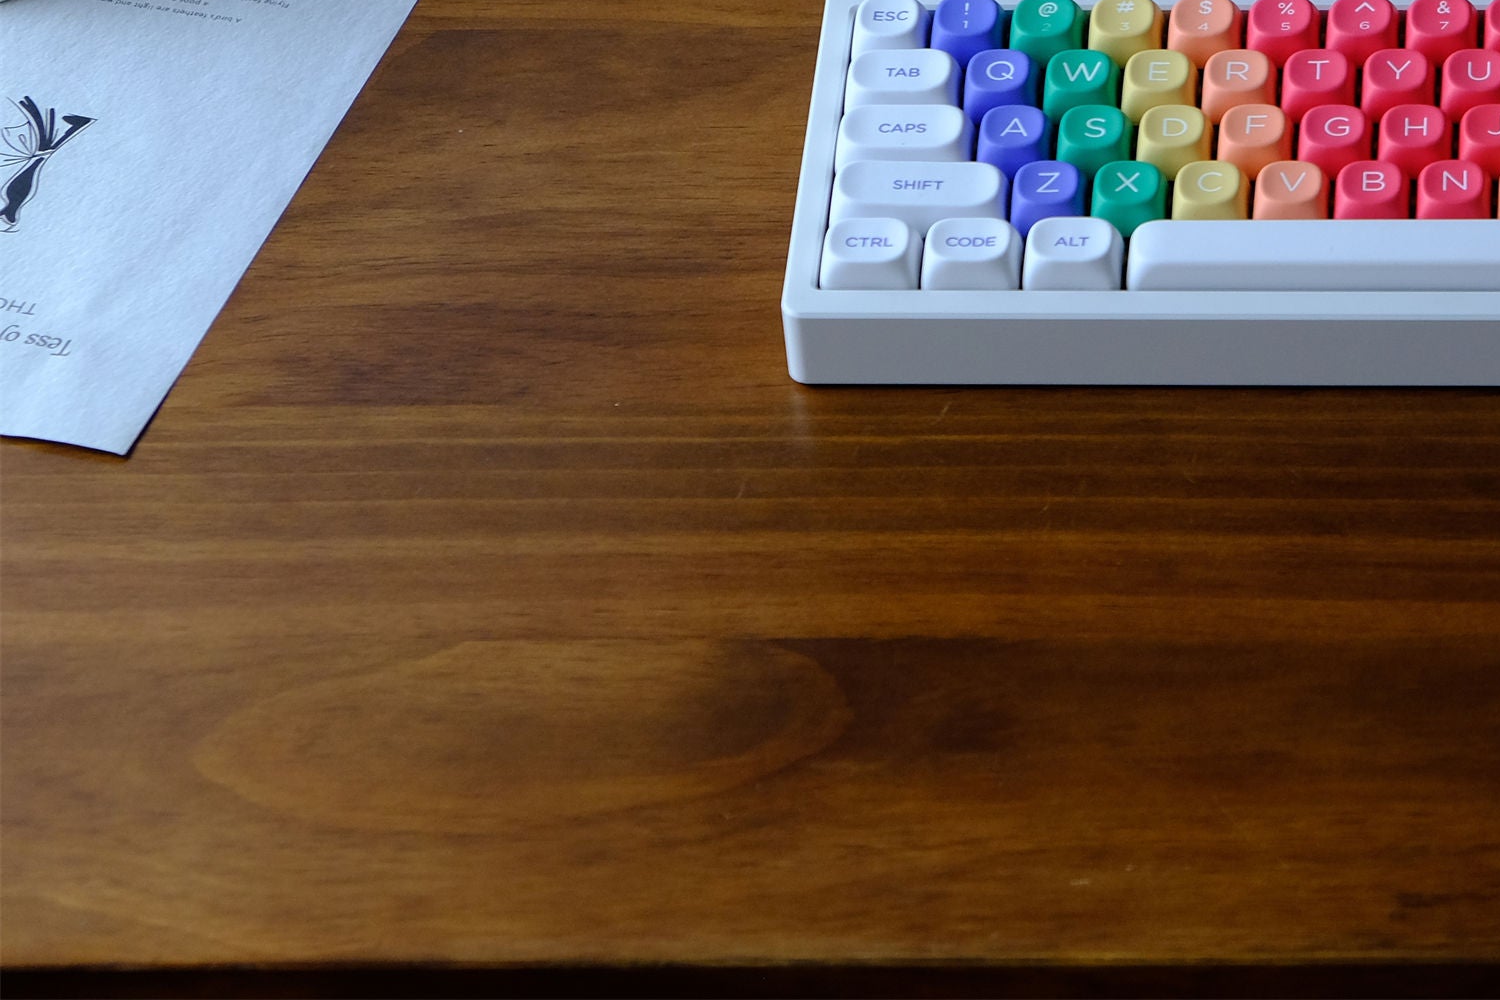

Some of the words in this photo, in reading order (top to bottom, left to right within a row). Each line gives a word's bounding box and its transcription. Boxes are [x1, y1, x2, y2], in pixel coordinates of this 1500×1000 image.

[133, 3, 154, 11] light
[172, 8, 207, 18] feathers
[873, 10, 908, 22] ESC
[209, 13, 233, 22] bird's
[1120, 22, 1130, 31] 3
[1197, 23, 1209, 31] 4
[1281, 22, 1290, 31] 5
[1359, 21, 1370, 30] 6
[1439, 21, 1449, 30] 7
[886, 67, 920, 78] TAB
[986, 61, 1015, 81] Q
[1063, 62, 1101, 82] W
[1148, 62, 1171, 81] E
[1227, 63, 1250, 80] R
[1307, 60, 1330, 79] T
[1386, 60, 1411, 79] Y
[1468, 61, 1490, 80] U
[878, 123, 927, 133] CAPS
[1000, 118, 1027, 137] A
[1084, 118, 1106, 138] S
[1163, 118, 1188, 137] D
[1246, 115, 1268, 134] F
[1324, 117, 1349, 137] G
[1404, 117, 1427, 136] H
[892, 180, 943, 190] SHIFT
[1037, 172, 1060, 193] Z
[1115, 172, 1140, 192] X
[1197, 172, 1223, 192] C
[1280, 172, 1306, 192] V
[1362, 172, 1385, 191] B
[1443, 171, 1467, 190] N
[845, 237, 893, 248] CTRL
[946, 236, 996, 247] CODE
[1054, 236, 1090, 247] ALT
[23, 333, 72, 357] Tess
